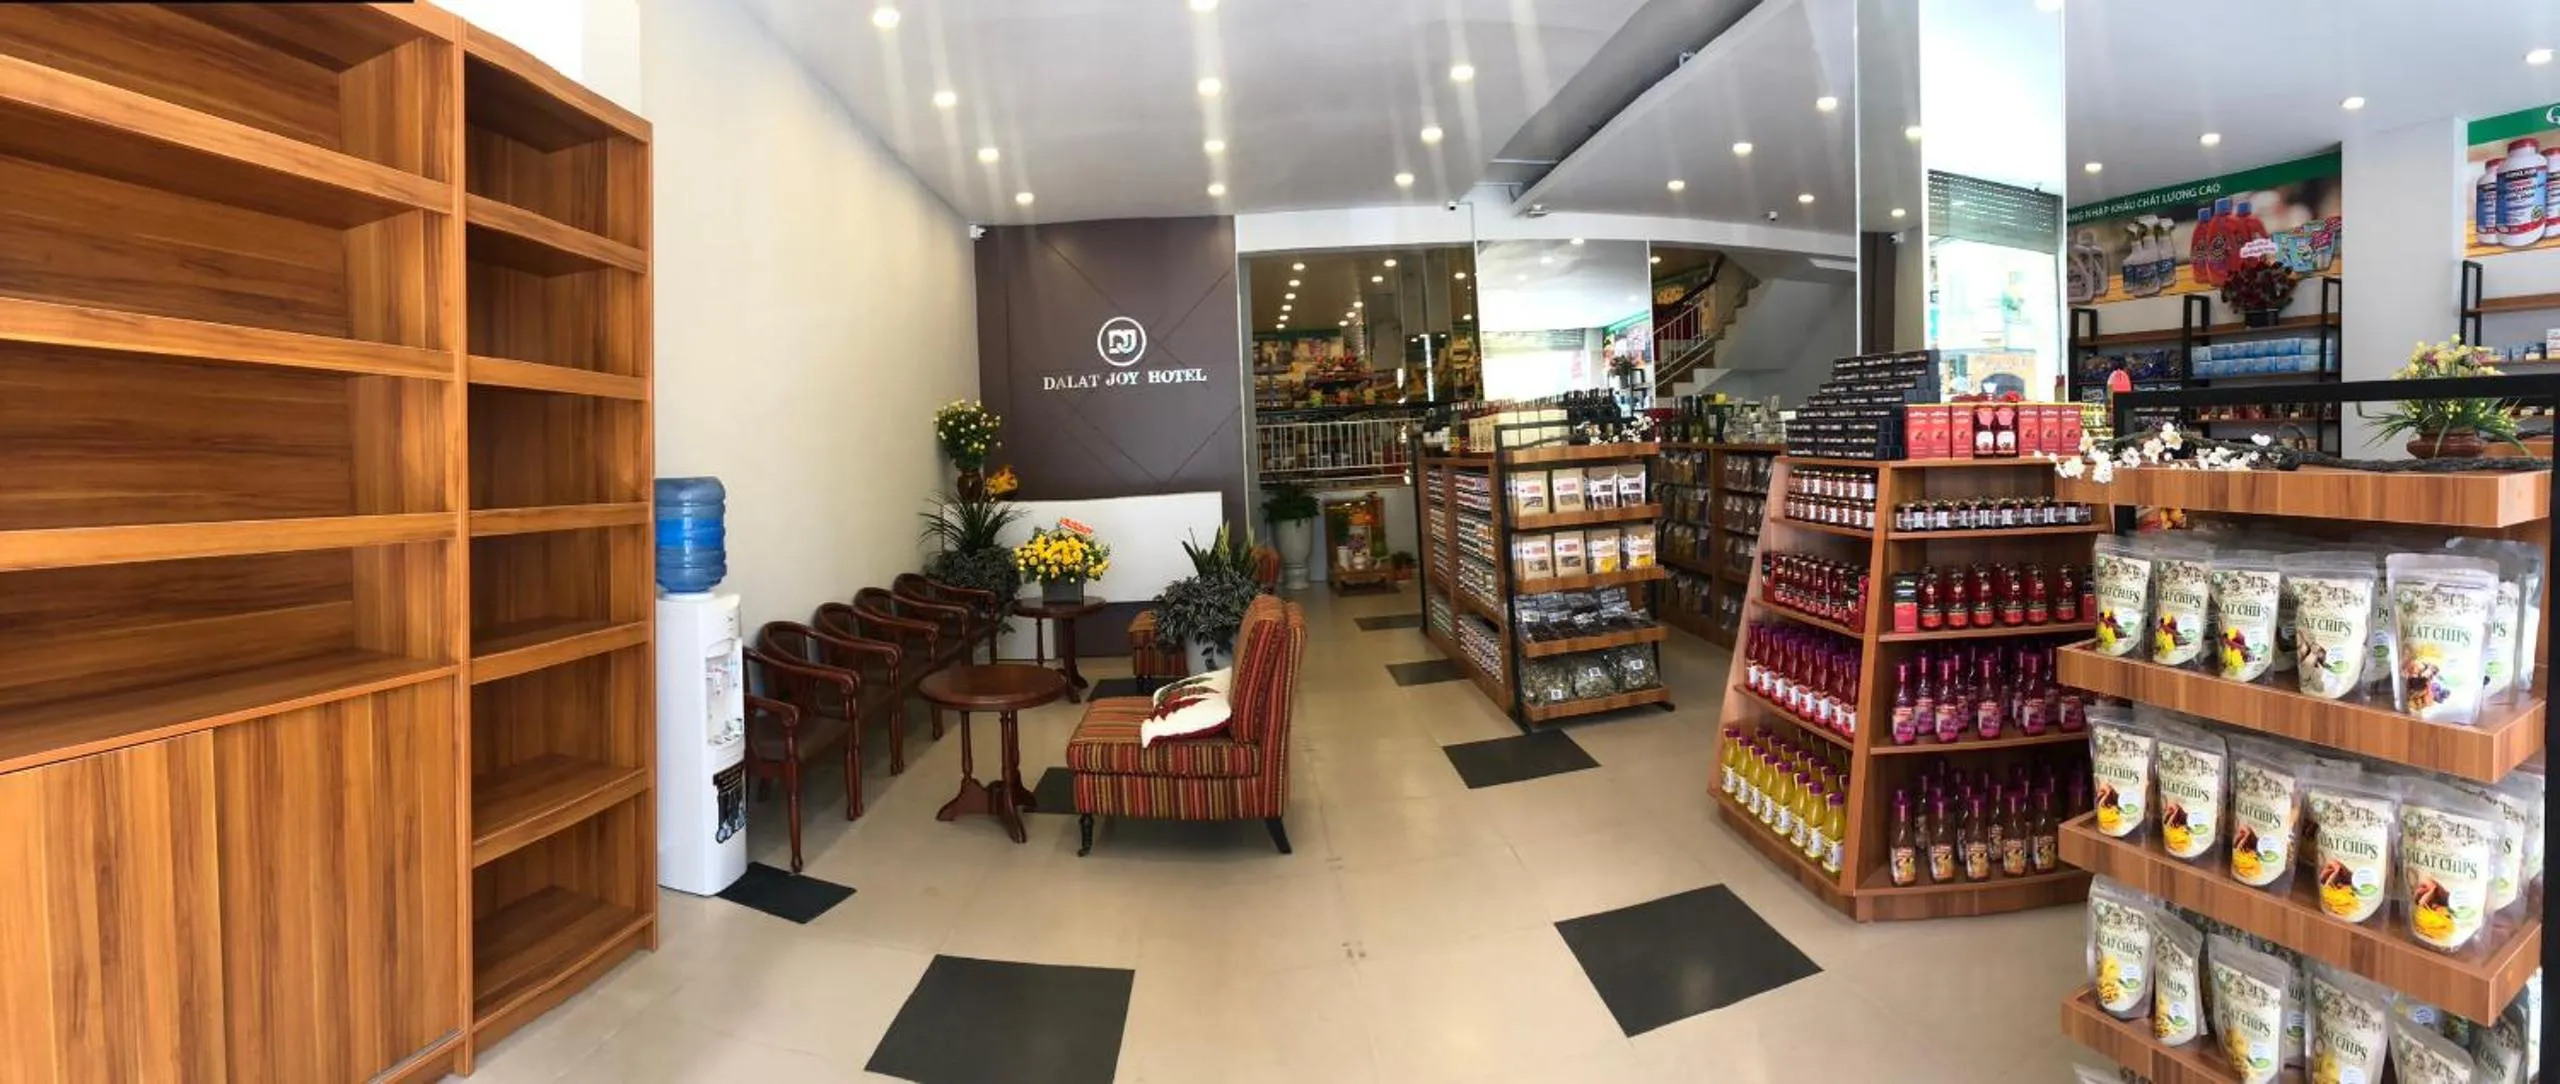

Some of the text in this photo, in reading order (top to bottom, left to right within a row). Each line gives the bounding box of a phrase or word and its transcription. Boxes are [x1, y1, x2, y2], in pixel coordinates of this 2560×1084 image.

[2199, 183, 2221, 196] CAO
[1043, 368, 1207, 390] DALAT JOY HOTEL
[2113, 586, 2140, 603] CHIPS
[2238, 603, 2270, 620] CHIPS
[2317, 618, 2351, 637] CHIPS
[2432, 627, 2472, 648] CHIPS
[2114, 767, 2140, 784] CHIPS
[2182, 785, 2210, 802] CHIPS
[2254, 807, 2281, 829] CHIPS
[2343, 836, 2378, 860] CHIPS
[2439, 857, 2477, 879] CHIPS
[2241, 1012, 2271, 1038] CHIPS
[2335, 1032, 2368, 1062] CHIPS
